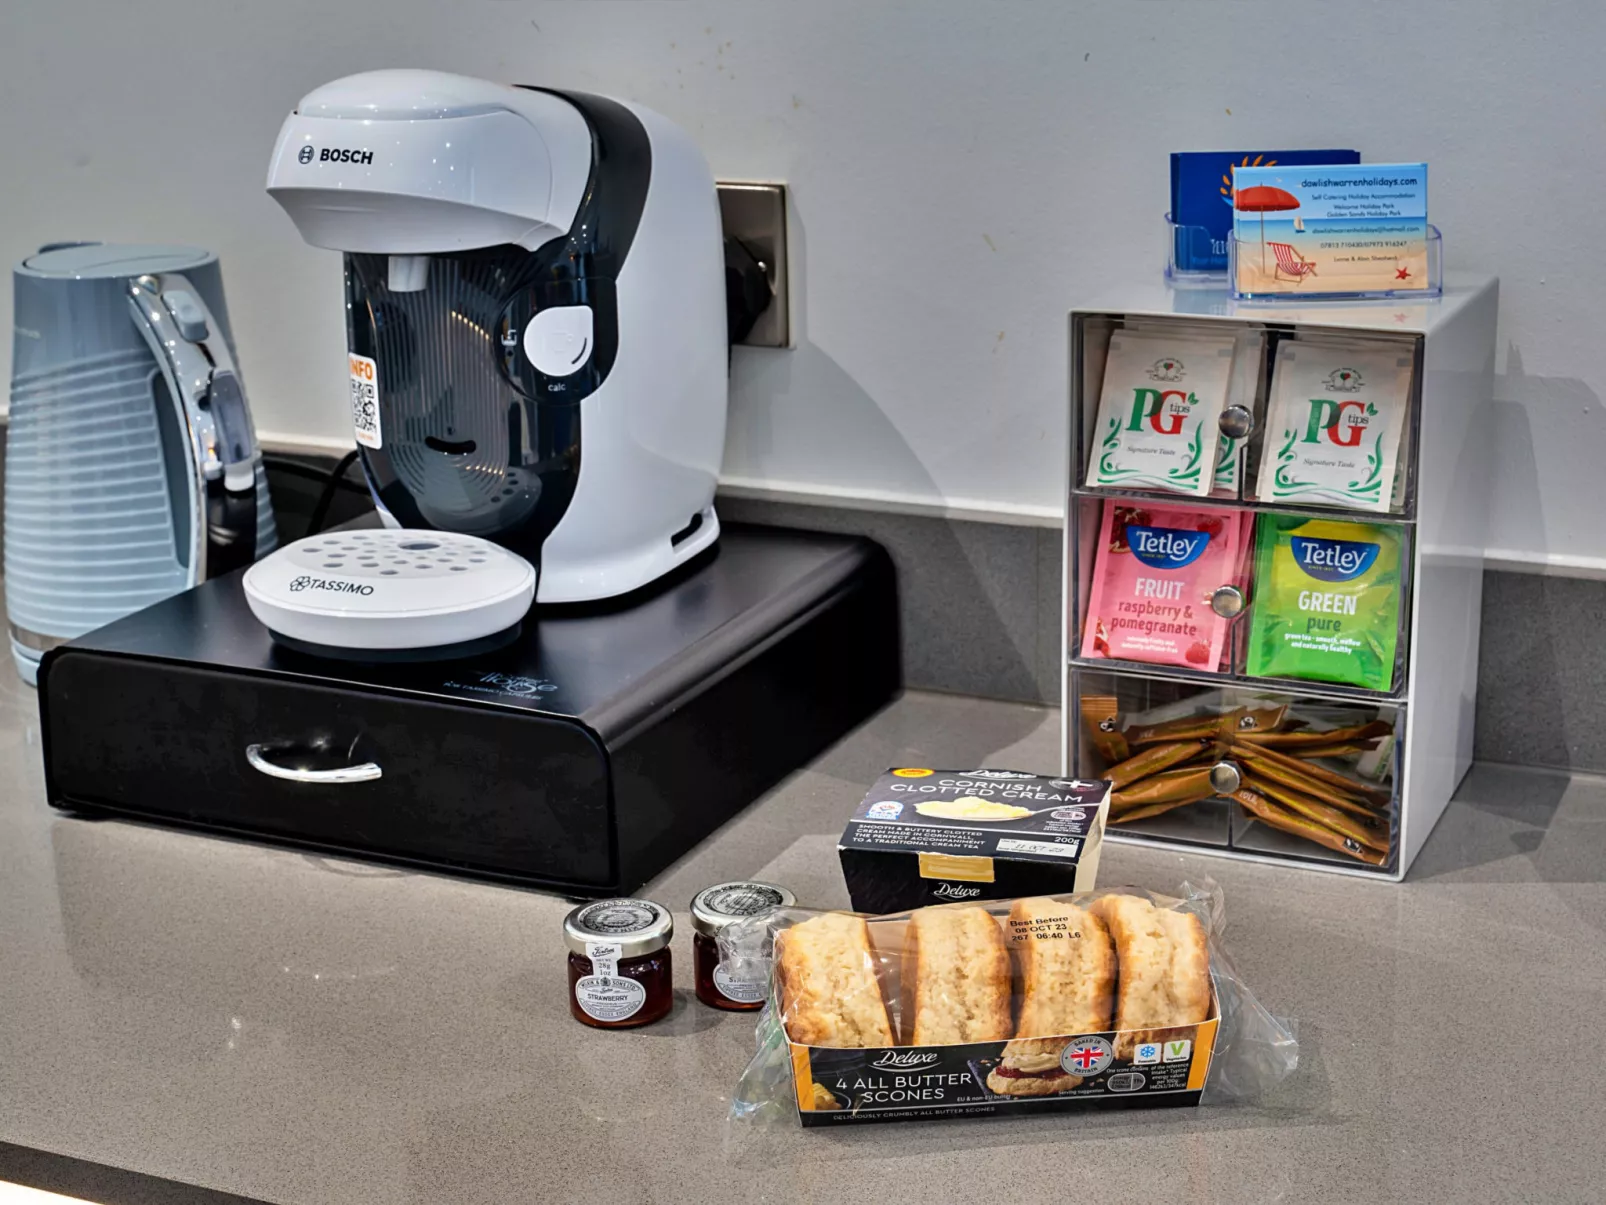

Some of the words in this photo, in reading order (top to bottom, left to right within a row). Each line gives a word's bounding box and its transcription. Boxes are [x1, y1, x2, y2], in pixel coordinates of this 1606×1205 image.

[319, 148, 374, 165] BOSCH
[1301, 176, 1418, 188] dawlishwarrenholidays.com
[547, 383, 567, 392] calc
[1125, 388, 1188, 435] PG
[1170, 403, 1191, 416] tips
[1300, 399, 1368, 448] PG
[1348, 414, 1370, 427] tips
[1135, 530, 1199, 561] Tetley
[1301, 542, 1368, 574] Tetley
[310, 579, 374, 596] TASSIMO
[1134, 577, 1186, 600] FRUIT
[1118, 600, 1182, 621] raspberry
[1183, 605, 1194, 619] &
[1297, 590, 1358, 616] GREEN
[1110, 617, 1197, 637] pomegranate
[1306, 616, 1342, 634] pure
[890, 784, 995, 797] CLOTTED
[1002, 790, 1083, 803] CREAM
[938, 779, 1042, 792] CORNISH
[911, 836, 986, 845] ACCOMPANIMENT
[1054, 837, 1080, 845] 200g
[933, 882, 980, 899] Deluxe
[1010, 919, 1034, 927] Best
[1035, 916, 1069, 926] Before
[1029, 924, 1053, 933] OCT
[1055, 923, 1068, 931] 23
[1036, 932, 1064, 940] 06:40
[1068, 931, 1081, 939] L6
[587, 993, 629, 1002] STRAWBERRY
[872, 1050, 939, 1067] Deluxe
[836, 1078, 848, 1090] 4
[853, 1076, 889, 1090] ALL
[895, 1073, 973, 1089] BUTTER
[862, 1088, 946, 1103] SCONES
[833, 1113, 881, 1121] DELICIOUSLY
[883, 1111, 919, 1119] CRUMBLY
